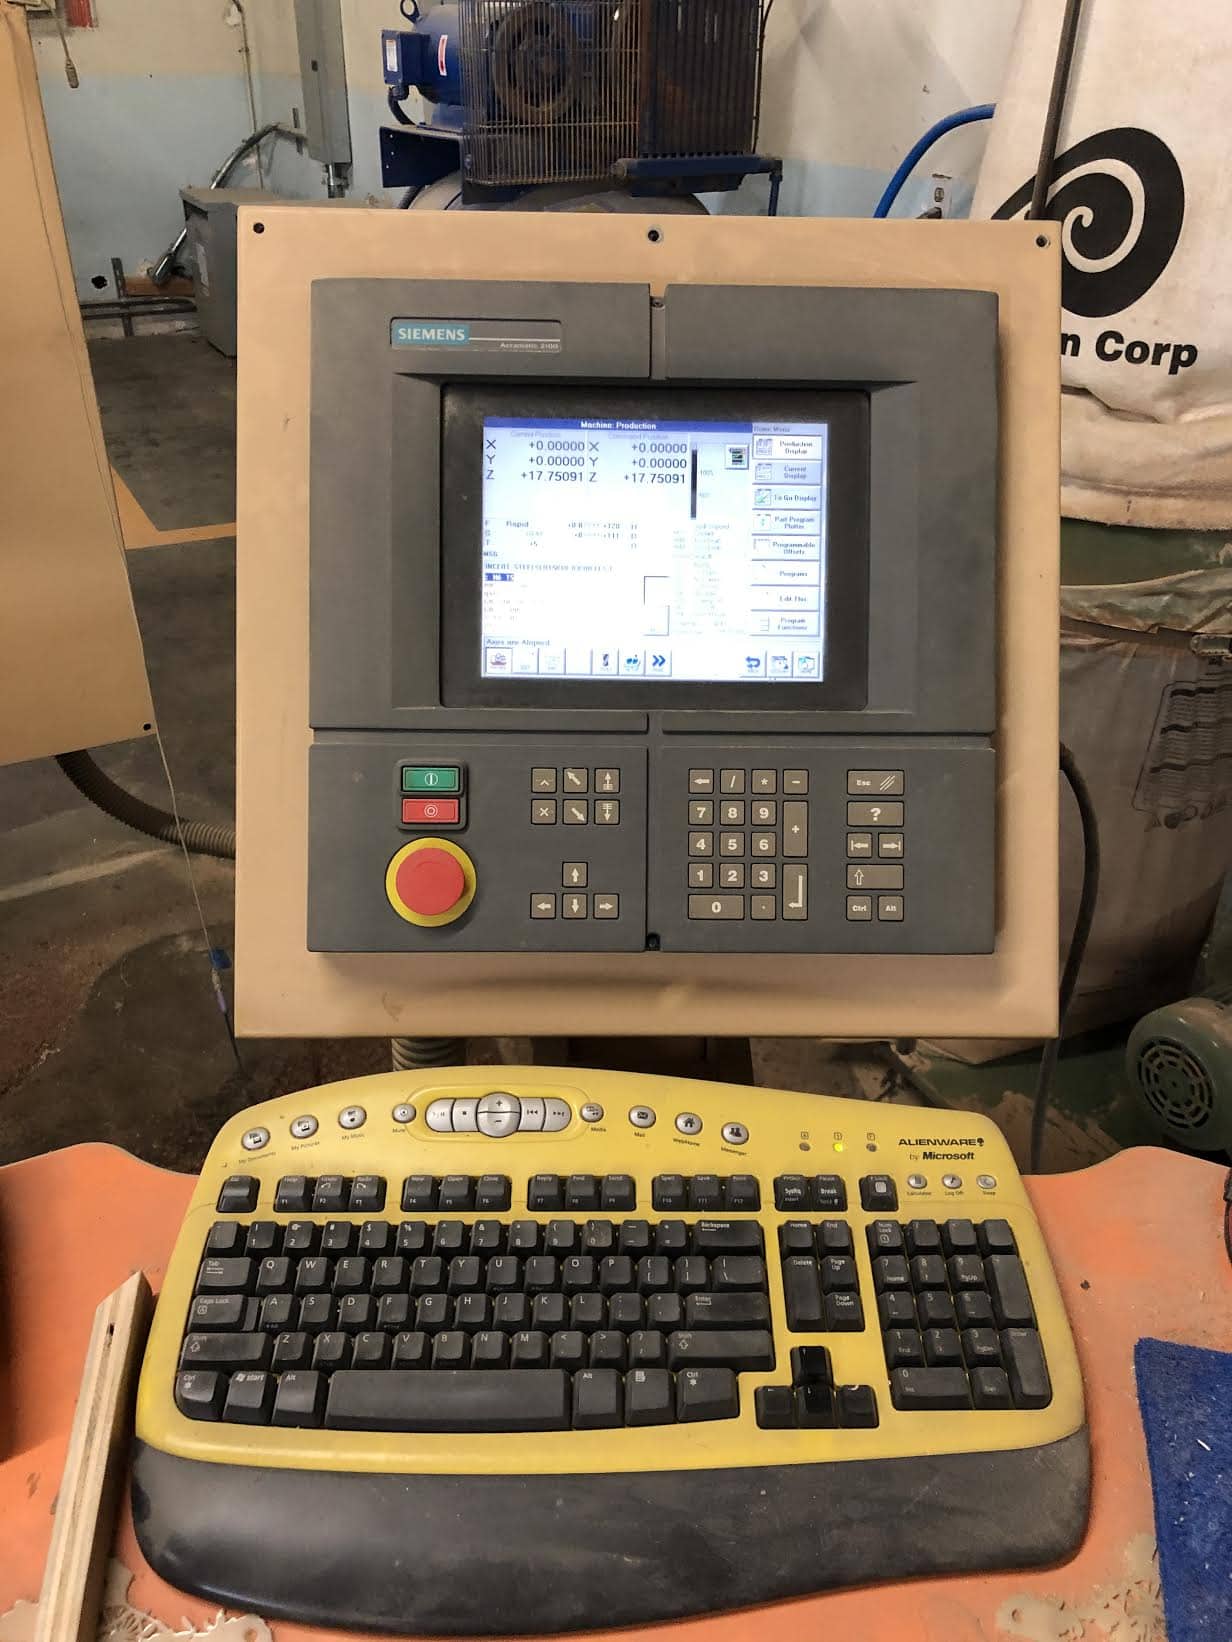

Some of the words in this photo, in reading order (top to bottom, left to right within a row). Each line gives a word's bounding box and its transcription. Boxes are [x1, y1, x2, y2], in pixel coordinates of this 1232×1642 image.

[398, 328, 465, 341] SIEMENS
[1095, 330, 1198, 375] Corp
[616, 421, 656, 430] Production
[485, 439, 497, 449] X
[529, 440, 585, 452] +0.00000
[588, 441, 600, 452] X
[631, 442, 687, 453] +0.00000
[485, 455, 496, 465] Y
[529, 455, 585, 467] +0.00000
[589, 457, 599, 467] Y
[631, 457, 687, 468] +0.00000
[486, 469, 495, 480] Z
[520, 471, 583, 483] +17.75091
[589, 472, 597, 482] Z
[624, 472, 686, 484] +17.75091
[697, 807, 706, 818] 7
[727, 808, 738, 819] 8
[759, 808, 769, 819] 9
[870, 808, 881, 821] ?
[696, 839, 706, 850] 4
[728, 839, 737, 850] 5
[759, 839, 769, 850] 6
[697, 870, 704, 881] 1
[727, 871, 738, 881] 2
[759, 871, 768, 881] 3
[711, 901, 722, 912] 0
[852, 904, 867, 912] Ctrl
[898, 1138, 977, 1146] ALIENWARE
[922, 1151, 975, 1161] Microsoft
[266, 1261, 275, 1269] Q
[381, 1260, 388, 1268] R
[420, 1260, 426, 1268] T
[495, 1260, 502, 1268] U
[572, 1259, 580, 1267] O
[608, 1259, 615, 1267] P
[308, 1297, 315, 1305] S
[282, 1335, 290, 1343] Z
[323, 1335, 331, 1343] X
[362, 1334, 370, 1342] C
[441, 1334, 447, 1342] B
[521, 1334, 529, 1342] M
[902, 1369, 909, 1377] 0
